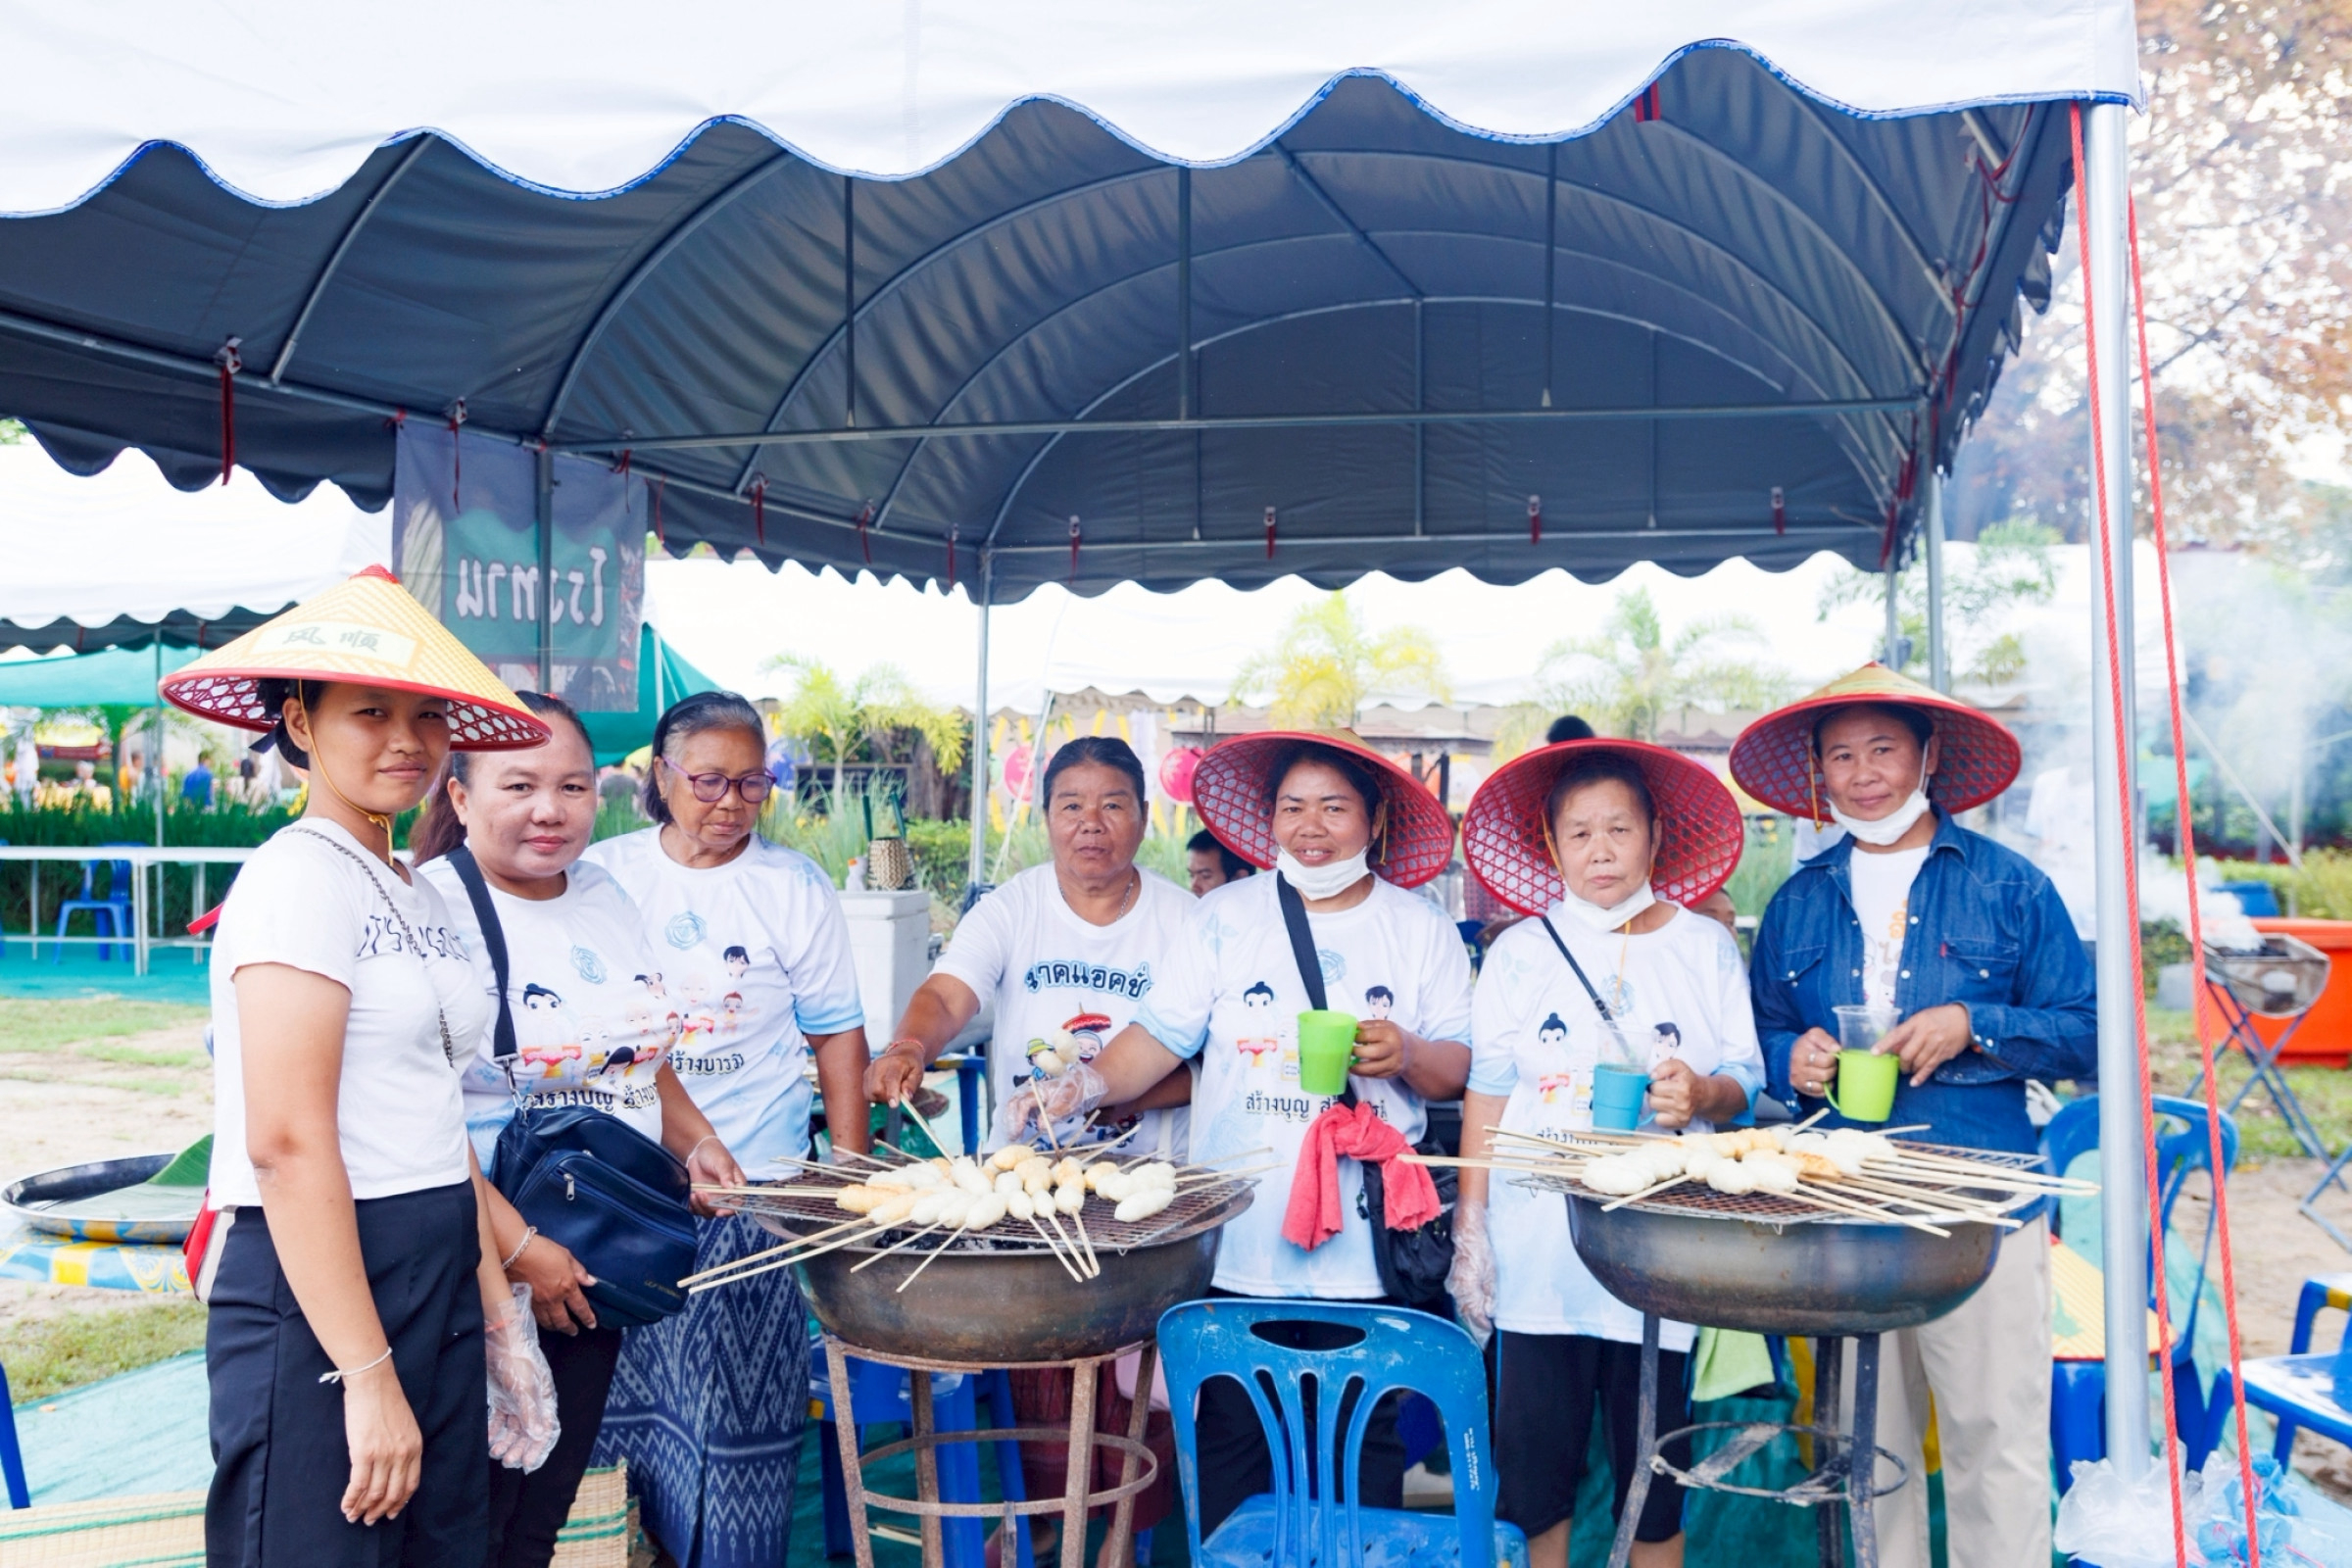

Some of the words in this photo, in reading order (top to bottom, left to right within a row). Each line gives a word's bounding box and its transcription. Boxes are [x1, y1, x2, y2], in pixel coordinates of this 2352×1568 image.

[1025, 961, 1153, 1000] นาคแอคชั่
[1246, 1090, 1310, 1119] สร้างบุญ
